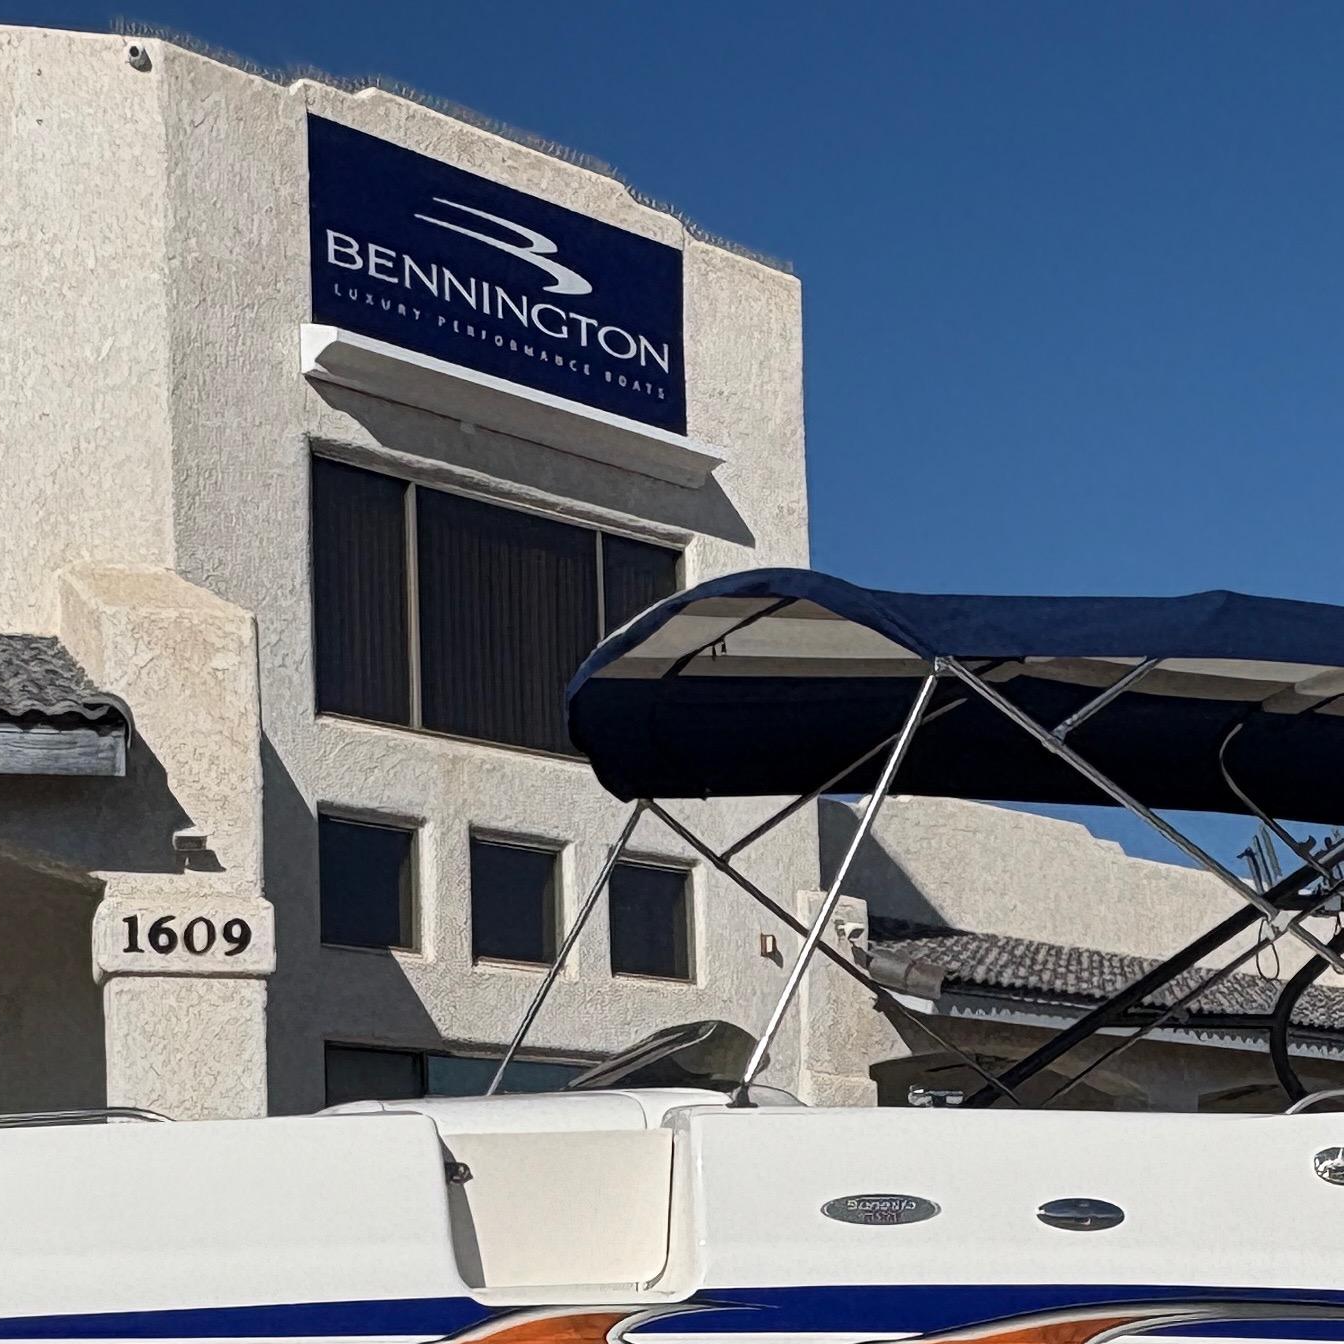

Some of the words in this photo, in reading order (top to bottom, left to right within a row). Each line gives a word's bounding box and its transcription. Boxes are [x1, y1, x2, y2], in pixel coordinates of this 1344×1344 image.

[325, 229, 669, 374] BENNINGTON
[334, 283, 421, 320] LUXURY
[438, 315, 590, 375] PERFORMANCE
[605, 371, 664, 399] BOATS
[122, 915, 252, 956] 1609
